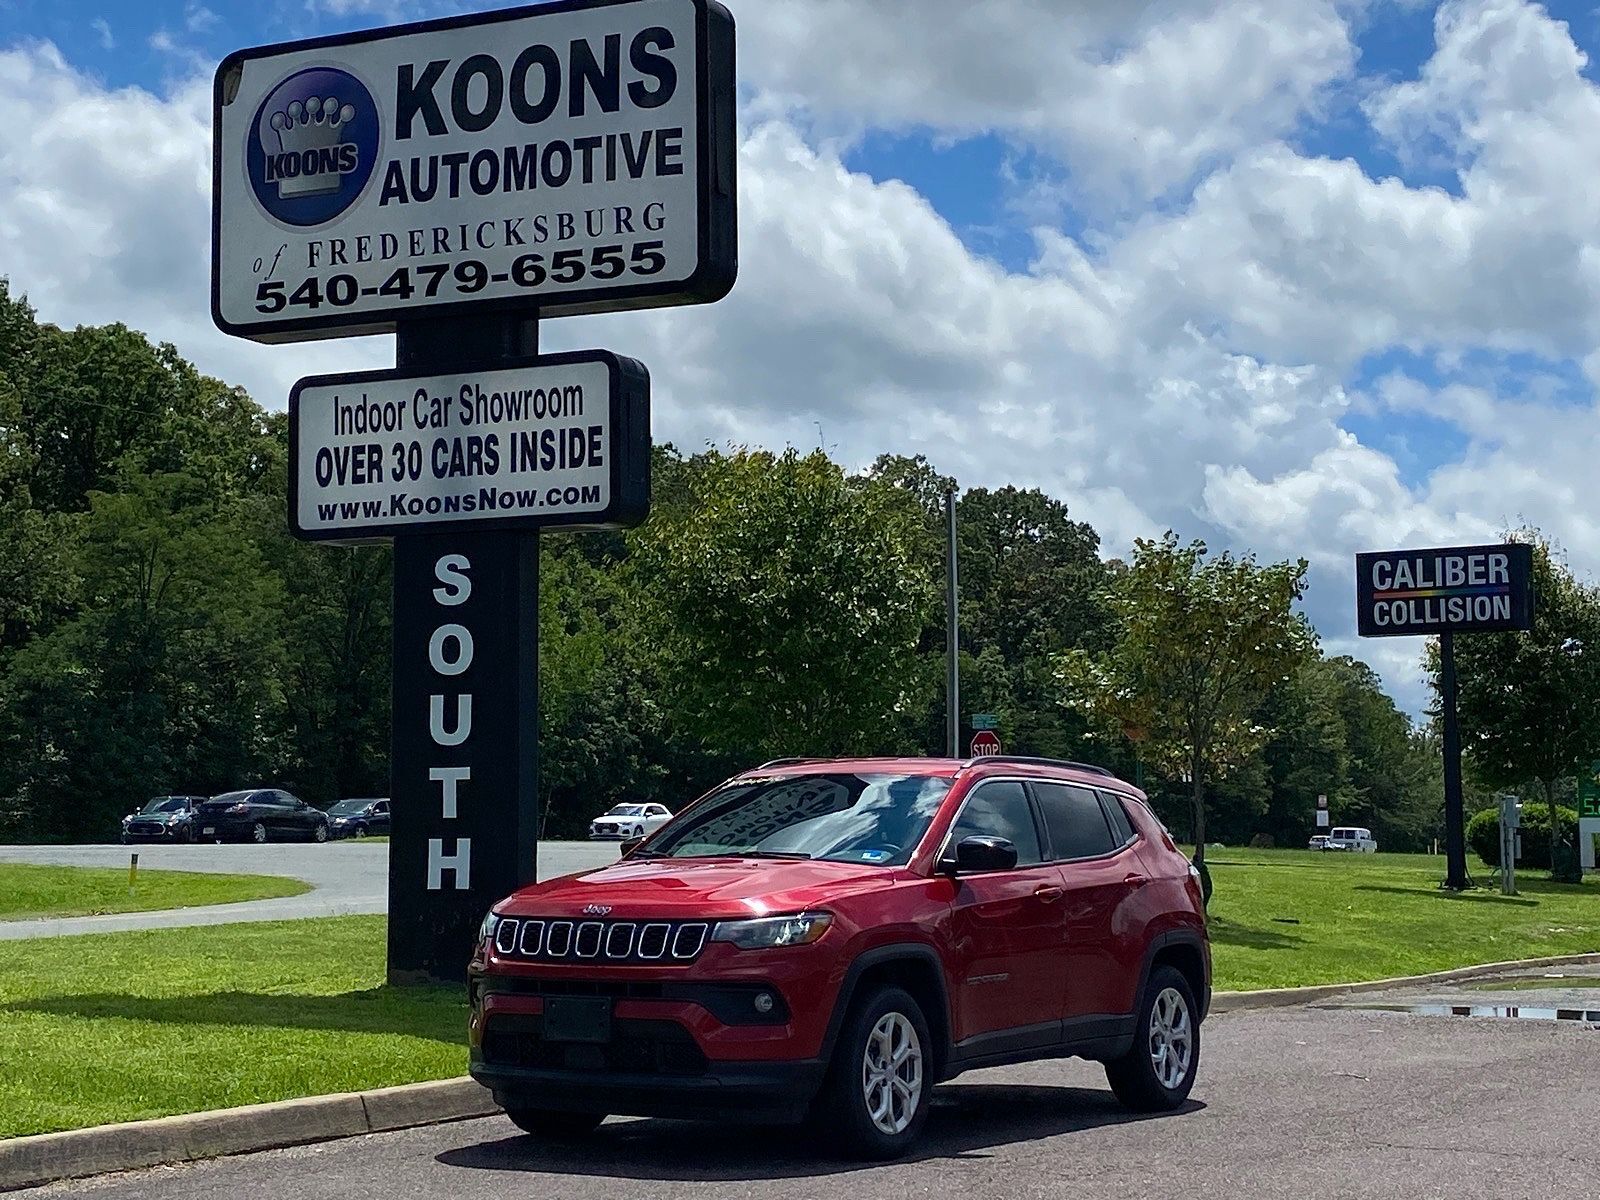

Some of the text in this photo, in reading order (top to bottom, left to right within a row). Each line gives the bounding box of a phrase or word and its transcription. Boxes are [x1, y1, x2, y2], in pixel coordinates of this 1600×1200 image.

[396, 27, 677, 140] KOONS
[265, 144, 359, 183] KOONS
[380, 127, 684, 206] AUTOMOTIVE
[253, 202, 667, 279] of FREDERICKSBURG
[255, 240, 666, 314] 540-479-6555
[333, 384, 583, 436] Indoor Car Showroom
[316, 425, 603, 487] OVER 30 CARS INSIDE
[1372, 554, 1510, 591] CALIBER
[1373, 595, 1511, 626] COLLISION
[427, 554, 474, 890] SOUTH
[973, 744, 999, 757] STOP
[1583, 798, 1600, 815] 5.
[582, 904, 612, 916] Jeep
